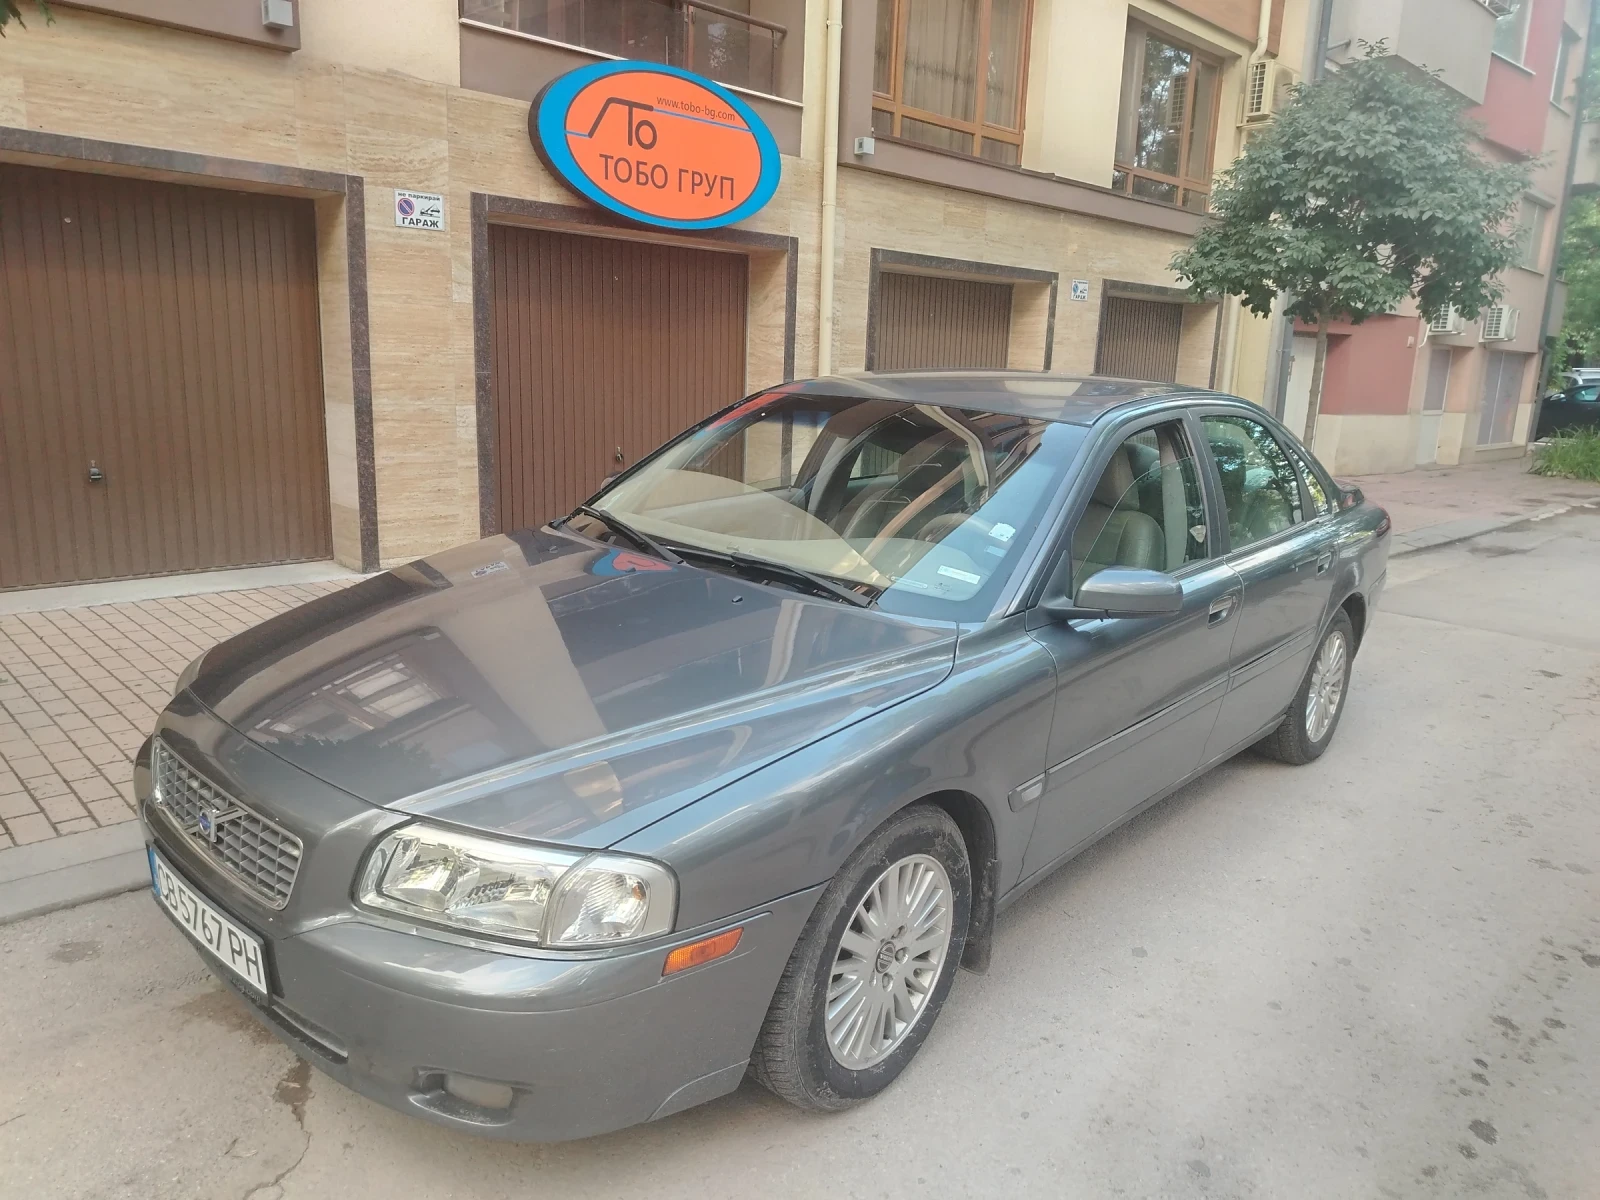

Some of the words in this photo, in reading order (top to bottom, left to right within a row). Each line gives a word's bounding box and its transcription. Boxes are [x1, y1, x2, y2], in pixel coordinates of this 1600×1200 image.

[656, 97, 736, 121] www.tobo-bg.com
[599, 153, 668, 189] ТОБО
[678, 168, 735, 201] ГРУП
[402, 217, 439, 228] ГАРАЖ
